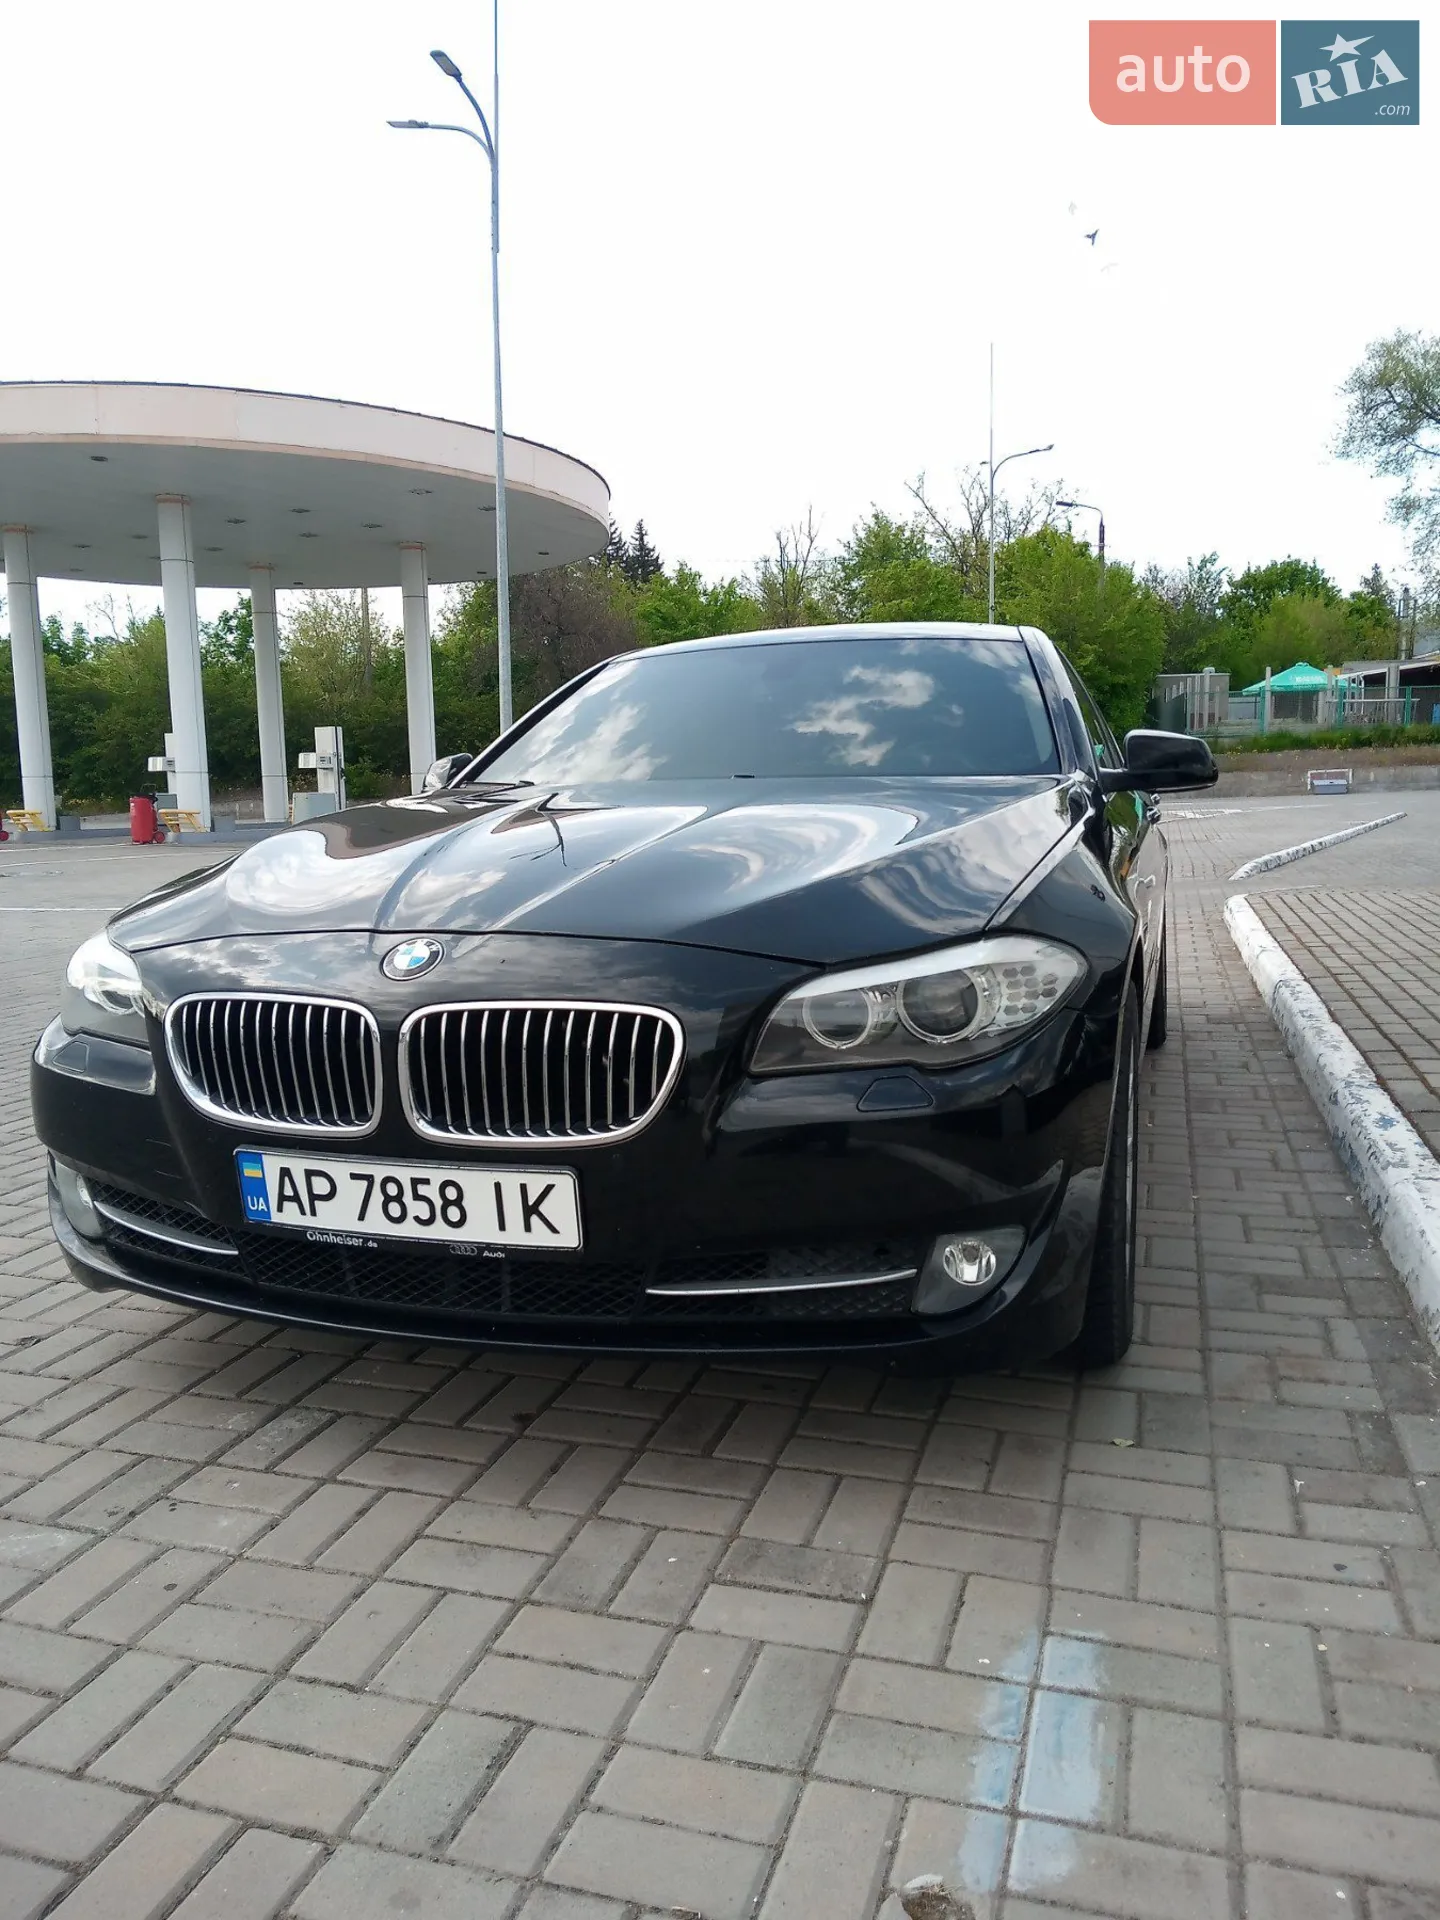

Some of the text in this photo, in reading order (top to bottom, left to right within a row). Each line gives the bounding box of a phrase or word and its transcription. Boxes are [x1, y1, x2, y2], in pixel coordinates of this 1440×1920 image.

[247, 1195, 268, 1212] UA
[277, 1166, 560, 1234] AP 7858 IK
